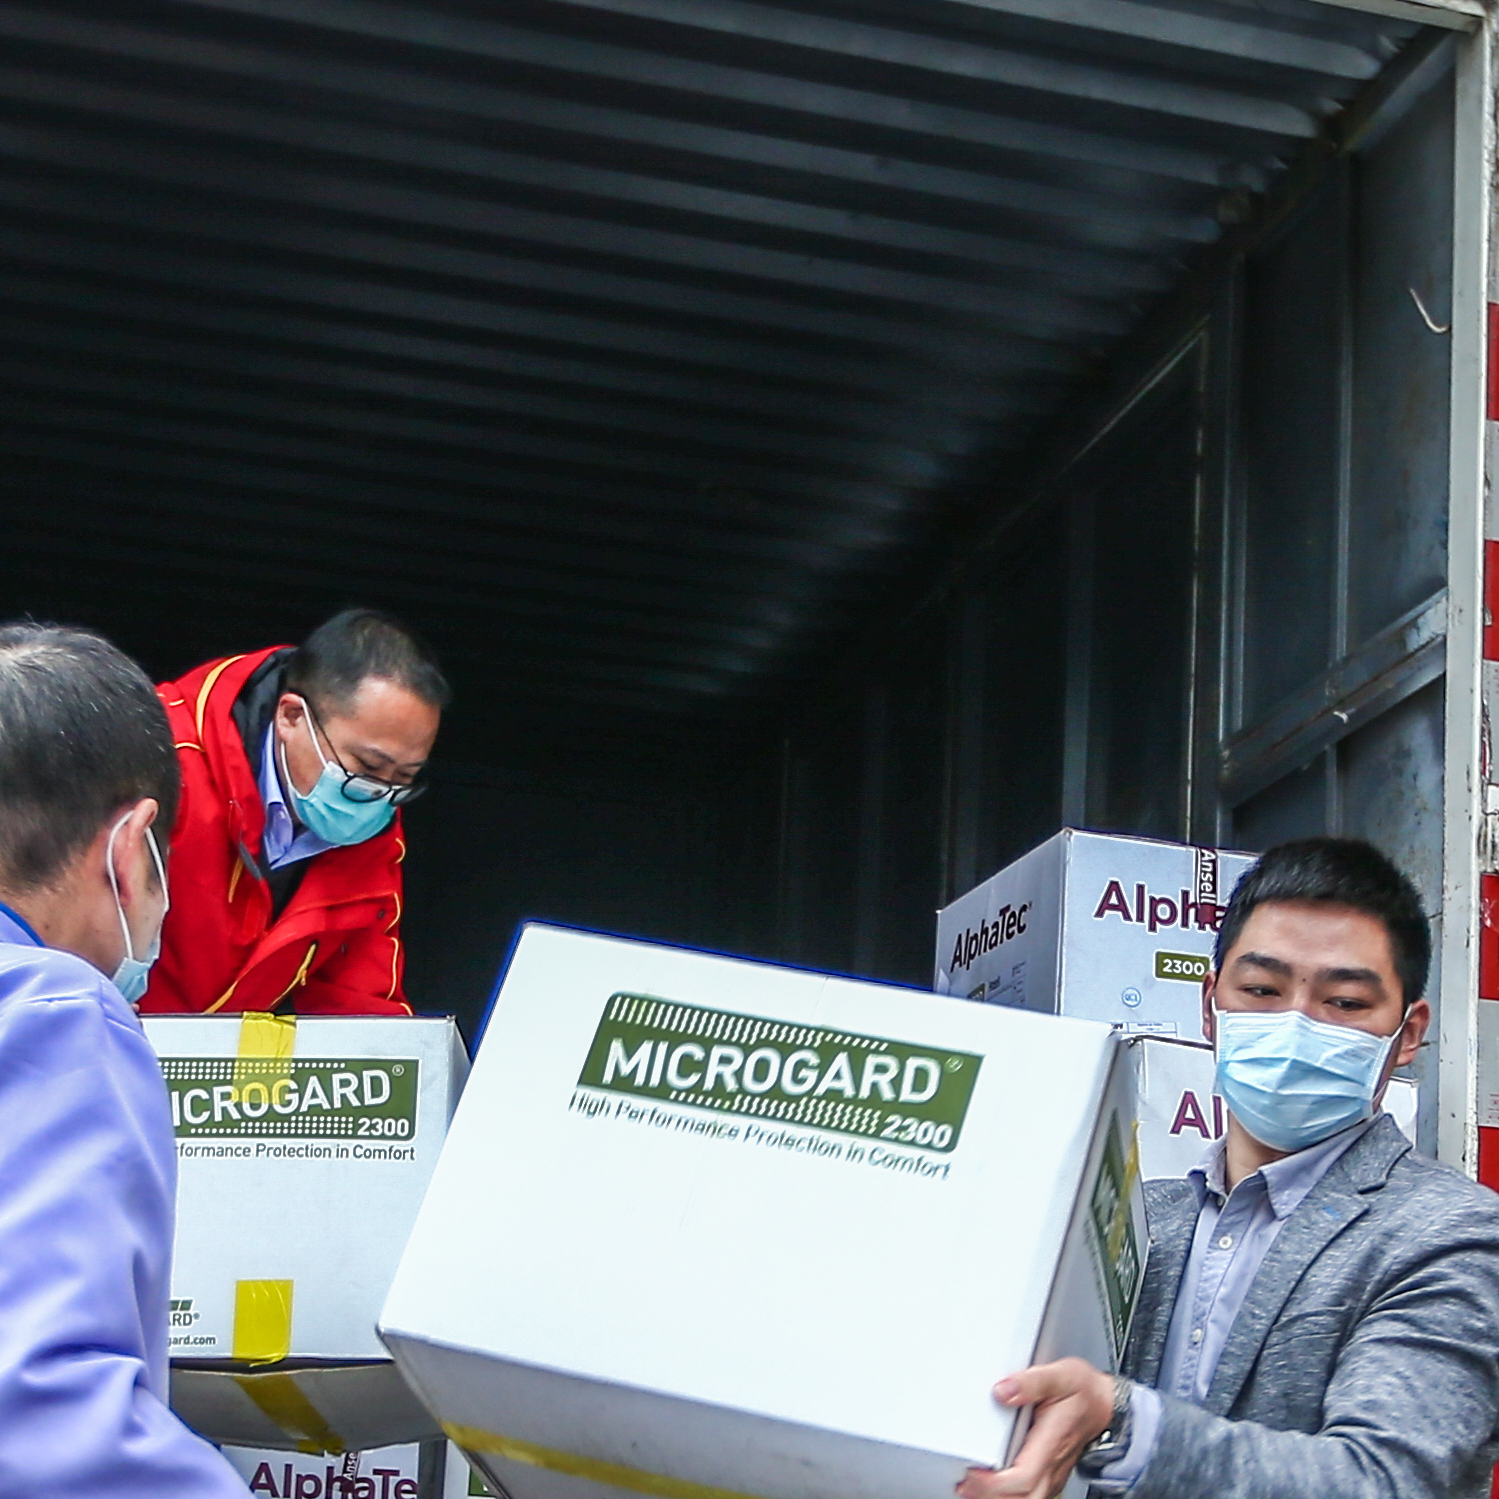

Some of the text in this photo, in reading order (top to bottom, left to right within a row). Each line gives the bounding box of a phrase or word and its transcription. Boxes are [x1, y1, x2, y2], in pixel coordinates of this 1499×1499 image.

[1201, 850, 1216, 903] Ansell
[1162, 958, 1205, 975] 2300
[357, 1117, 409, 1136] 2300
[568, 1089, 953, 1182] High Performance Protection in Comfort
[879, 1113, 956, 1149] 2300
[175, 1142, 415, 1161] formance Protection in Comfort
